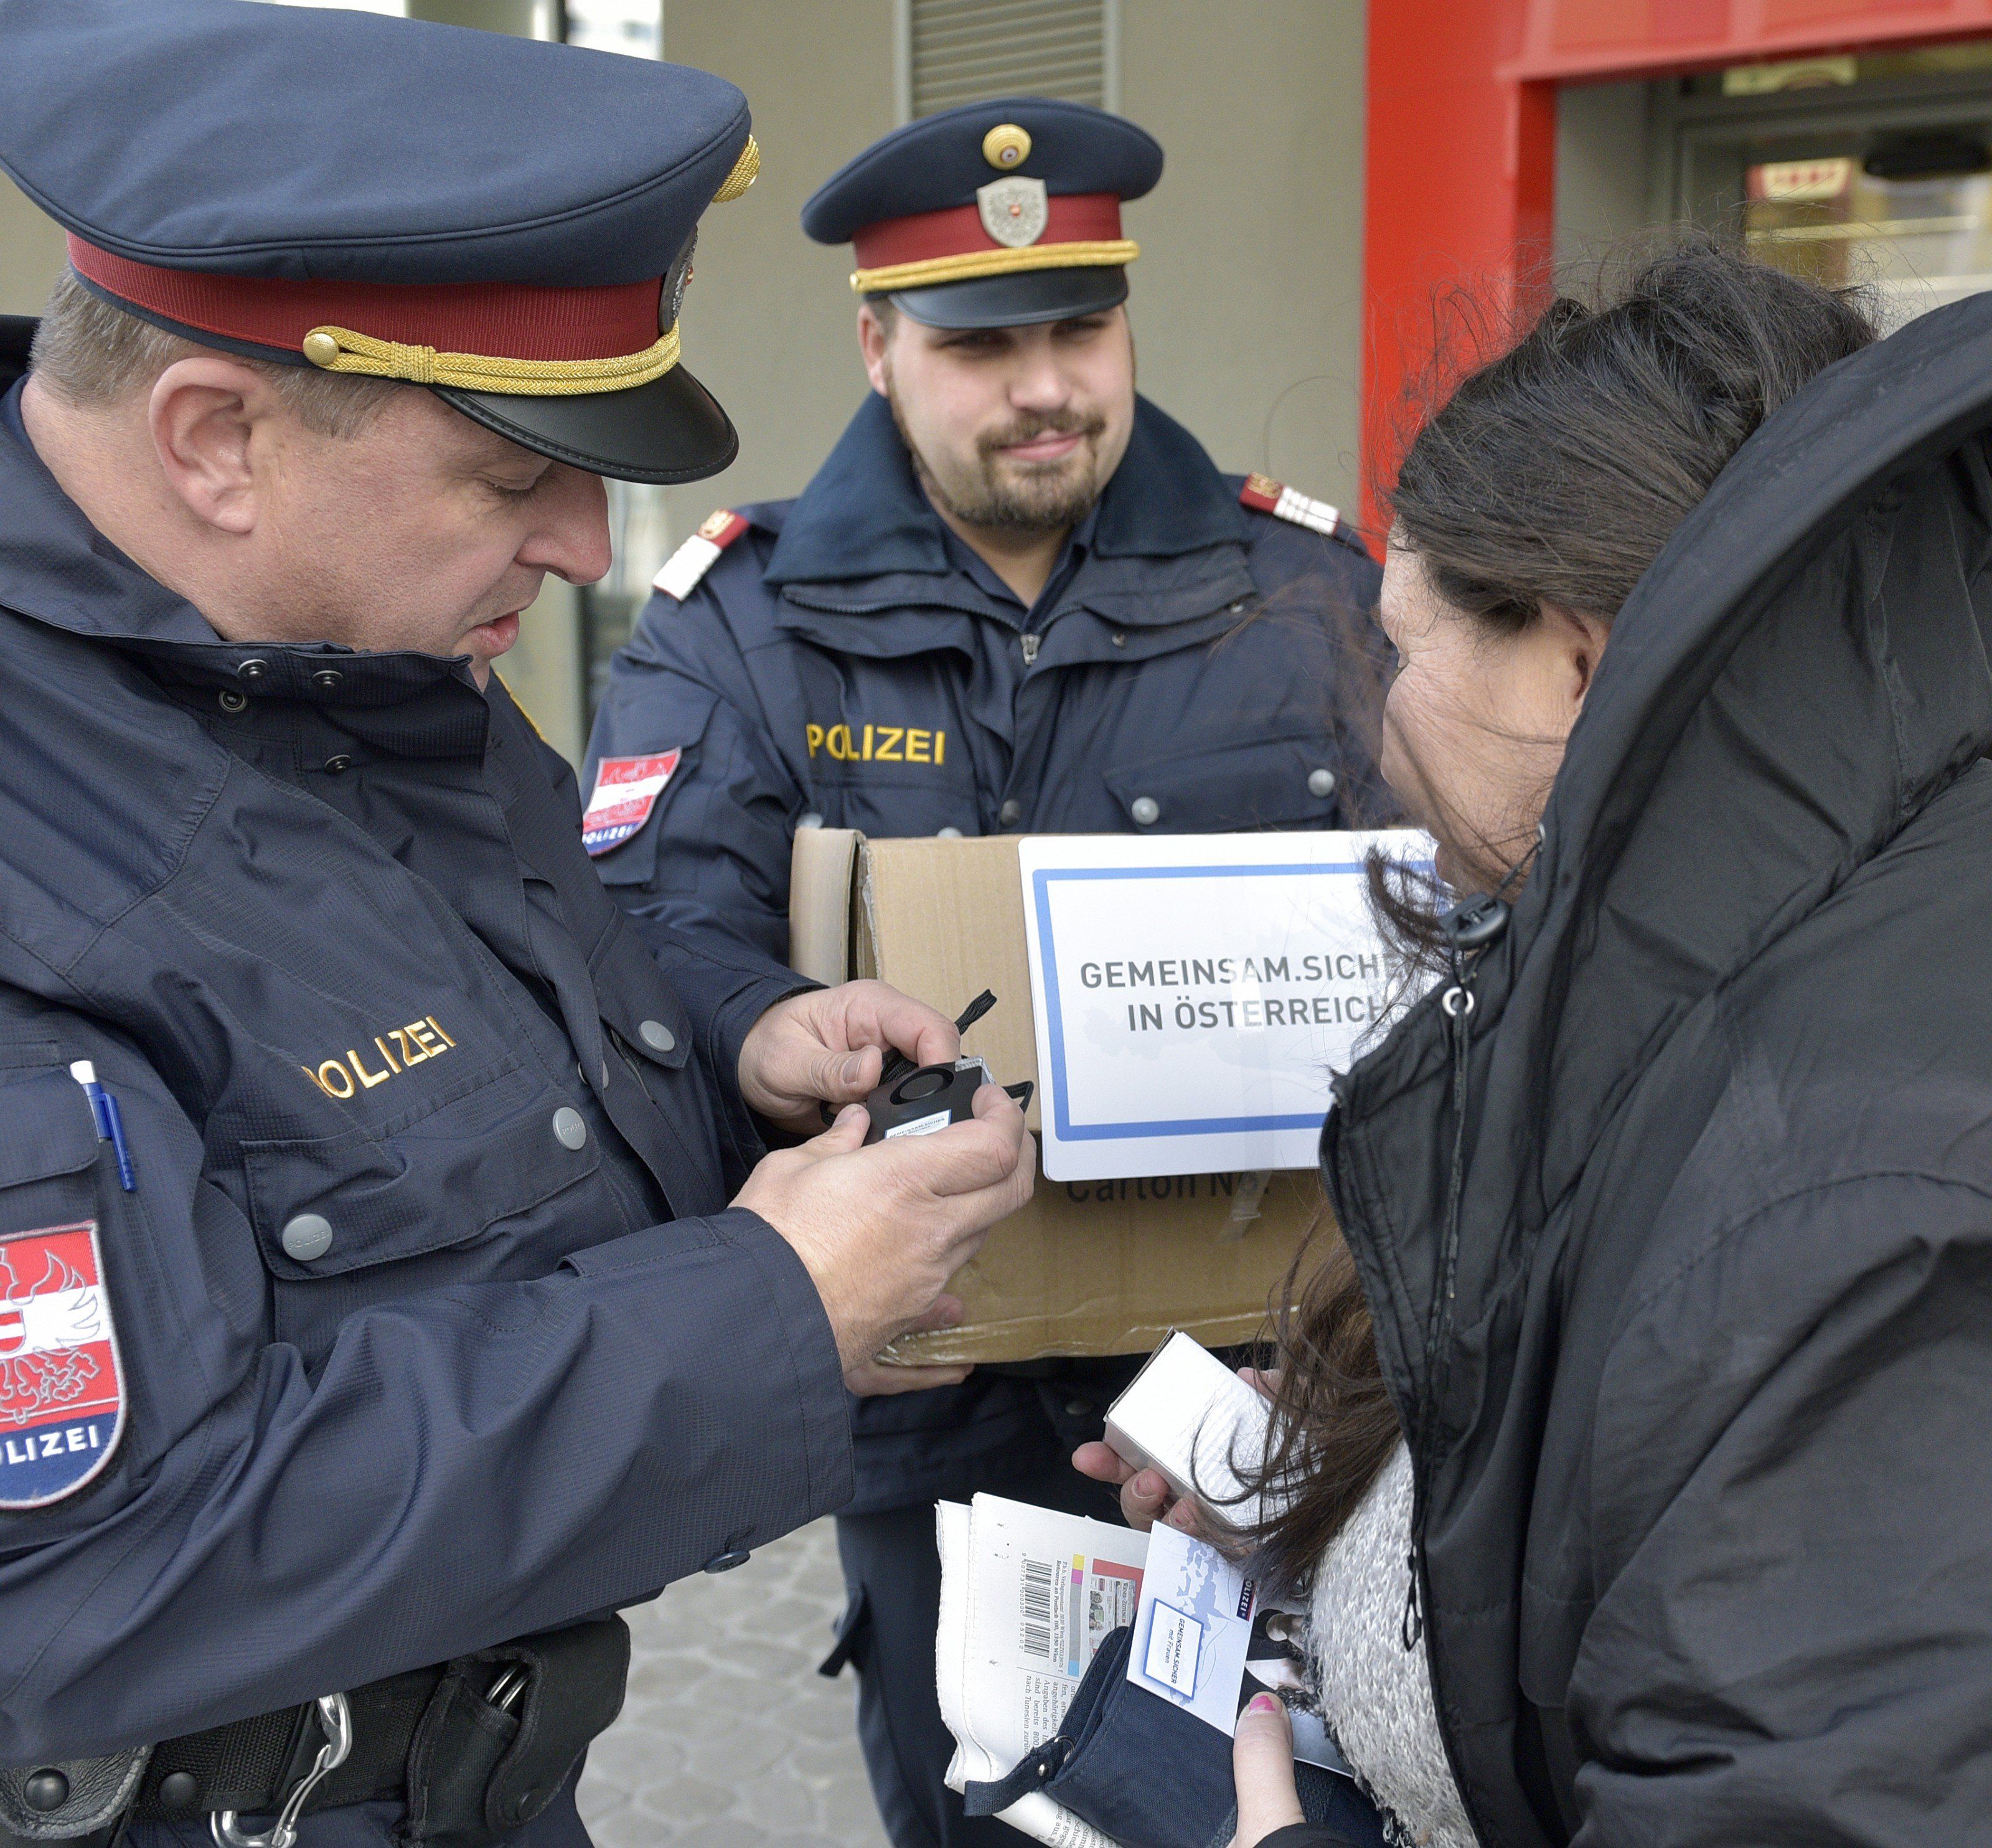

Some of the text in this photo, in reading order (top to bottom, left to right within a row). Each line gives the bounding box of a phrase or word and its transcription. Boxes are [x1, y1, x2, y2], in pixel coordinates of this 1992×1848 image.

[806, 724, 945, 766] POLIZEI
[1080, 954, 1401, 989] GEMEINSAM.SICH
[1128, 996, 1386, 1031] IN ÖSTERREICH
[0, 1425, 100, 1464] LIZEI
[1241, 1580, 1252, 1612] OLIZEI
[1165, 1641, 1173, 1664] Frauen
[1171, 1618, 1185, 1684] GEMEINSAM.SICHER
[1023, 1695, 1031, 1729] Tunesien
[1042, 1679, 1050, 1712] Angaben
[1051, 1682, 1059, 1734] angehörigkeit,
